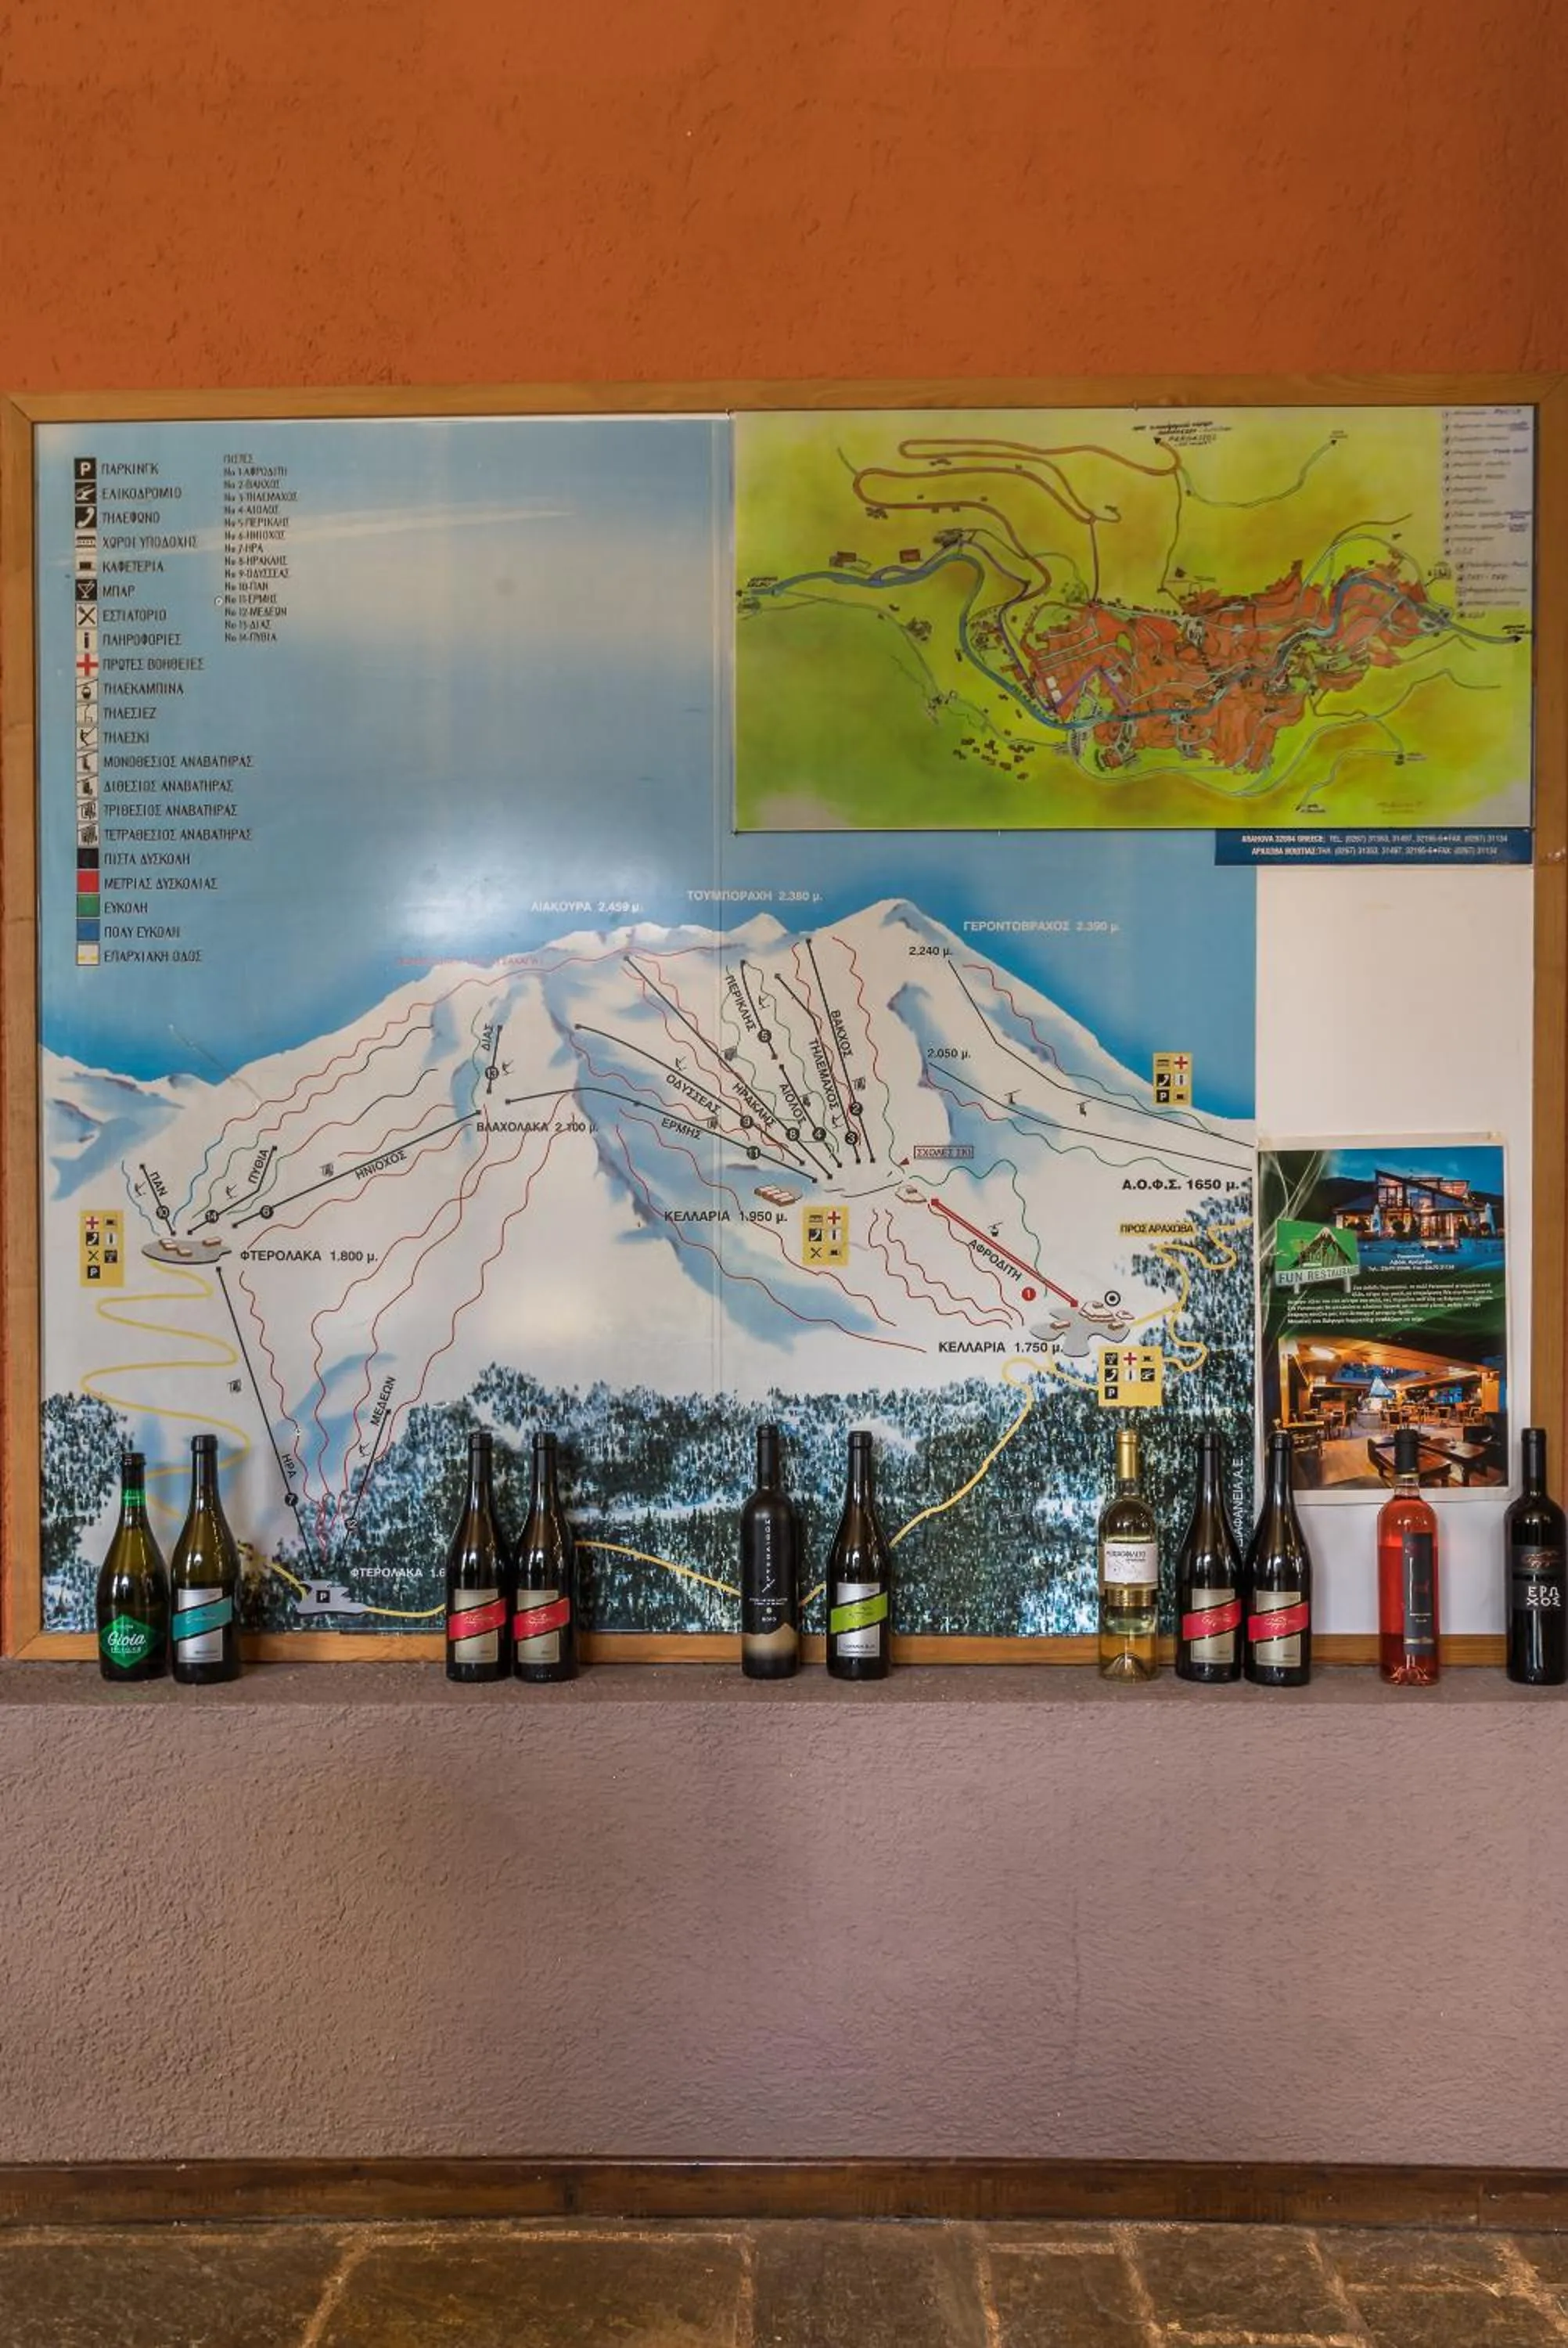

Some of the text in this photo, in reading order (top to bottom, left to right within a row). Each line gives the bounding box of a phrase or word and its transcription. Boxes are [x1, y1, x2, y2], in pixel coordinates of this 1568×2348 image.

[102, 463, 159, 475] ΠΑΡΚΙΝΓΚ
[102, 488, 182, 499] ΕΛΙΚΟΔΡΟΜΙΟ
[102, 512, 160, 524] ΤΗΛΕΦΩΝΟ
[102, 535, 198, 548] ΧΩΡΟΙ ΥΠΟΔΟΧΗΣ
[102, 560, 164, 572] ΚΑΦΕΤΕΡΙΑ
[102, 585, 135, 596] ΜΠΑΡ
[102, 610, 167, 621] ΕΣΤΙΑΤΟΡΙΟ
[102, 634, 182, 646] ΠΛΗΡΟΦΟΡΙΕΣ
[103, 658, 205, 671] ΠΡΩΤΕΣ ΒΟΗΘΕΙΕΣ
[104, 683, 184, 695] ΤΗΛΕΚΑΜΠΙΝΑ
[104, 708, 156, 718] ΤΗΛΕΣΙΕΖ
[104, 732, 149, 744] ΤΗΛΕΣΚΙ
[104, 756, 254, 768] ΜΟΝΟΘΕΣΙΟΣ ΑΝΑΒΑΤΗΡΑΣ
[104, 780, 234, 792] ΔΙΘΕΣΙΟΣ ΑΝΑΒΑΤΗΡΑΣ
[104, 805, 239, 816] ΤΡΙΘΕΣΙΟΣ ΑΝΑΒΑΤΗΡΑΣ
[105, 829, 253, 841] ΤΕΤΡΑΘΕΣΙΟΣ ΑΝΑΒΑΤΗΡΑΣ
[104, 853, 190, 865] ΠΙΣΤΑ ΔΥΣΚΟΛΗ
[104, 877, 218, 889] ΜΕΤΡΙΑΣ ΔΥΣΚΟΛΙΑΣ
[687, 891, 772, 901] ΤΟΥΜΠΟΡΑΧΗ
[104, 902, 148, 913] ΕΥΚΟΛΗ
[530, 902, 592, 912] ΛΙΑΚΟΥΡΑ
[104, 926, 180, 938] ΠΟΛΥ ΕΥΚΟΛΗ
[963, 921, 1069, 931] ΓΕΡΟΝΤΟΒΡΑΧΟΣ
[104, 950, 202, 962] ΕΠΑΡΧΙΑΚΗ ΟΔΟΣ
[909, 946, 940, 956] 2.240
[725, 974, 757, 1033] ΠΕΡΙΚΛΗΣ
[483, 1024, 494, 1050] ΔΙΑΣ
[830, 1010, 853, 1057] ΒΑΚΧΟΣ
[927, 1048, 958, 1058] 2.050
[809, 1039, 840, 1111] ΤΗΛΕΜΑΧΟΣ
[666, 1074, 721, 1113] ΟΔΥΣΣΕΑΣ
[732, 1082, 777, 1128] ΗΡΑΚΛΗΣ
[779, 1083, 807, 1123] ΑΙΟΛΟΣ
[477, 1123, 548, 1132] ΒΛΑΧΟΛΑΚΑ
[661, 1117, 702, 1140] ΕΡΜΗΣ
[249, 1150, 269, 1184] ΠΥΘΙΑ
[354, 1150, 408, 1180] ΗΝΙΟΧΟΣ
[150, 1172, 168, 1196] ΠΑΝ
[1122, 1180, 1239, 1193] Α.Ο.Φ.Σ. 1650 μ.
[664, 1212, 787, 1224] ΚΕΛΛΑΡΙΑ 1.950 μ.
[1120, 1224, 1193, 1233] ΠΡΟΣ ΑΡΑΧΩΒΑ
[241, 1251, 378, 1263] ΦΤΕΡΟΛΑΚΑ 1.800 μ.
[968, 1239, 1022, 1282] ΑΦΡΟΔΙΤΗ
[1279, 1273, 1303, 1284] FUN
[1308, 1266, 1359, 1280] RESTAURA
[939, 1342, 1063, 1355] ΚΕΛΛΑΡΙΑ 1.750 μ.
[371, 1376, 396, 1427] ΜΕΔΕΩΝ
[282, 1453, 297, 1479] ΗΡΑ
[351, 1568, 423, 1577] ΦΤΕΡΟΛΑΚΑ
[108, 1631, 146, 1645] Gioia
